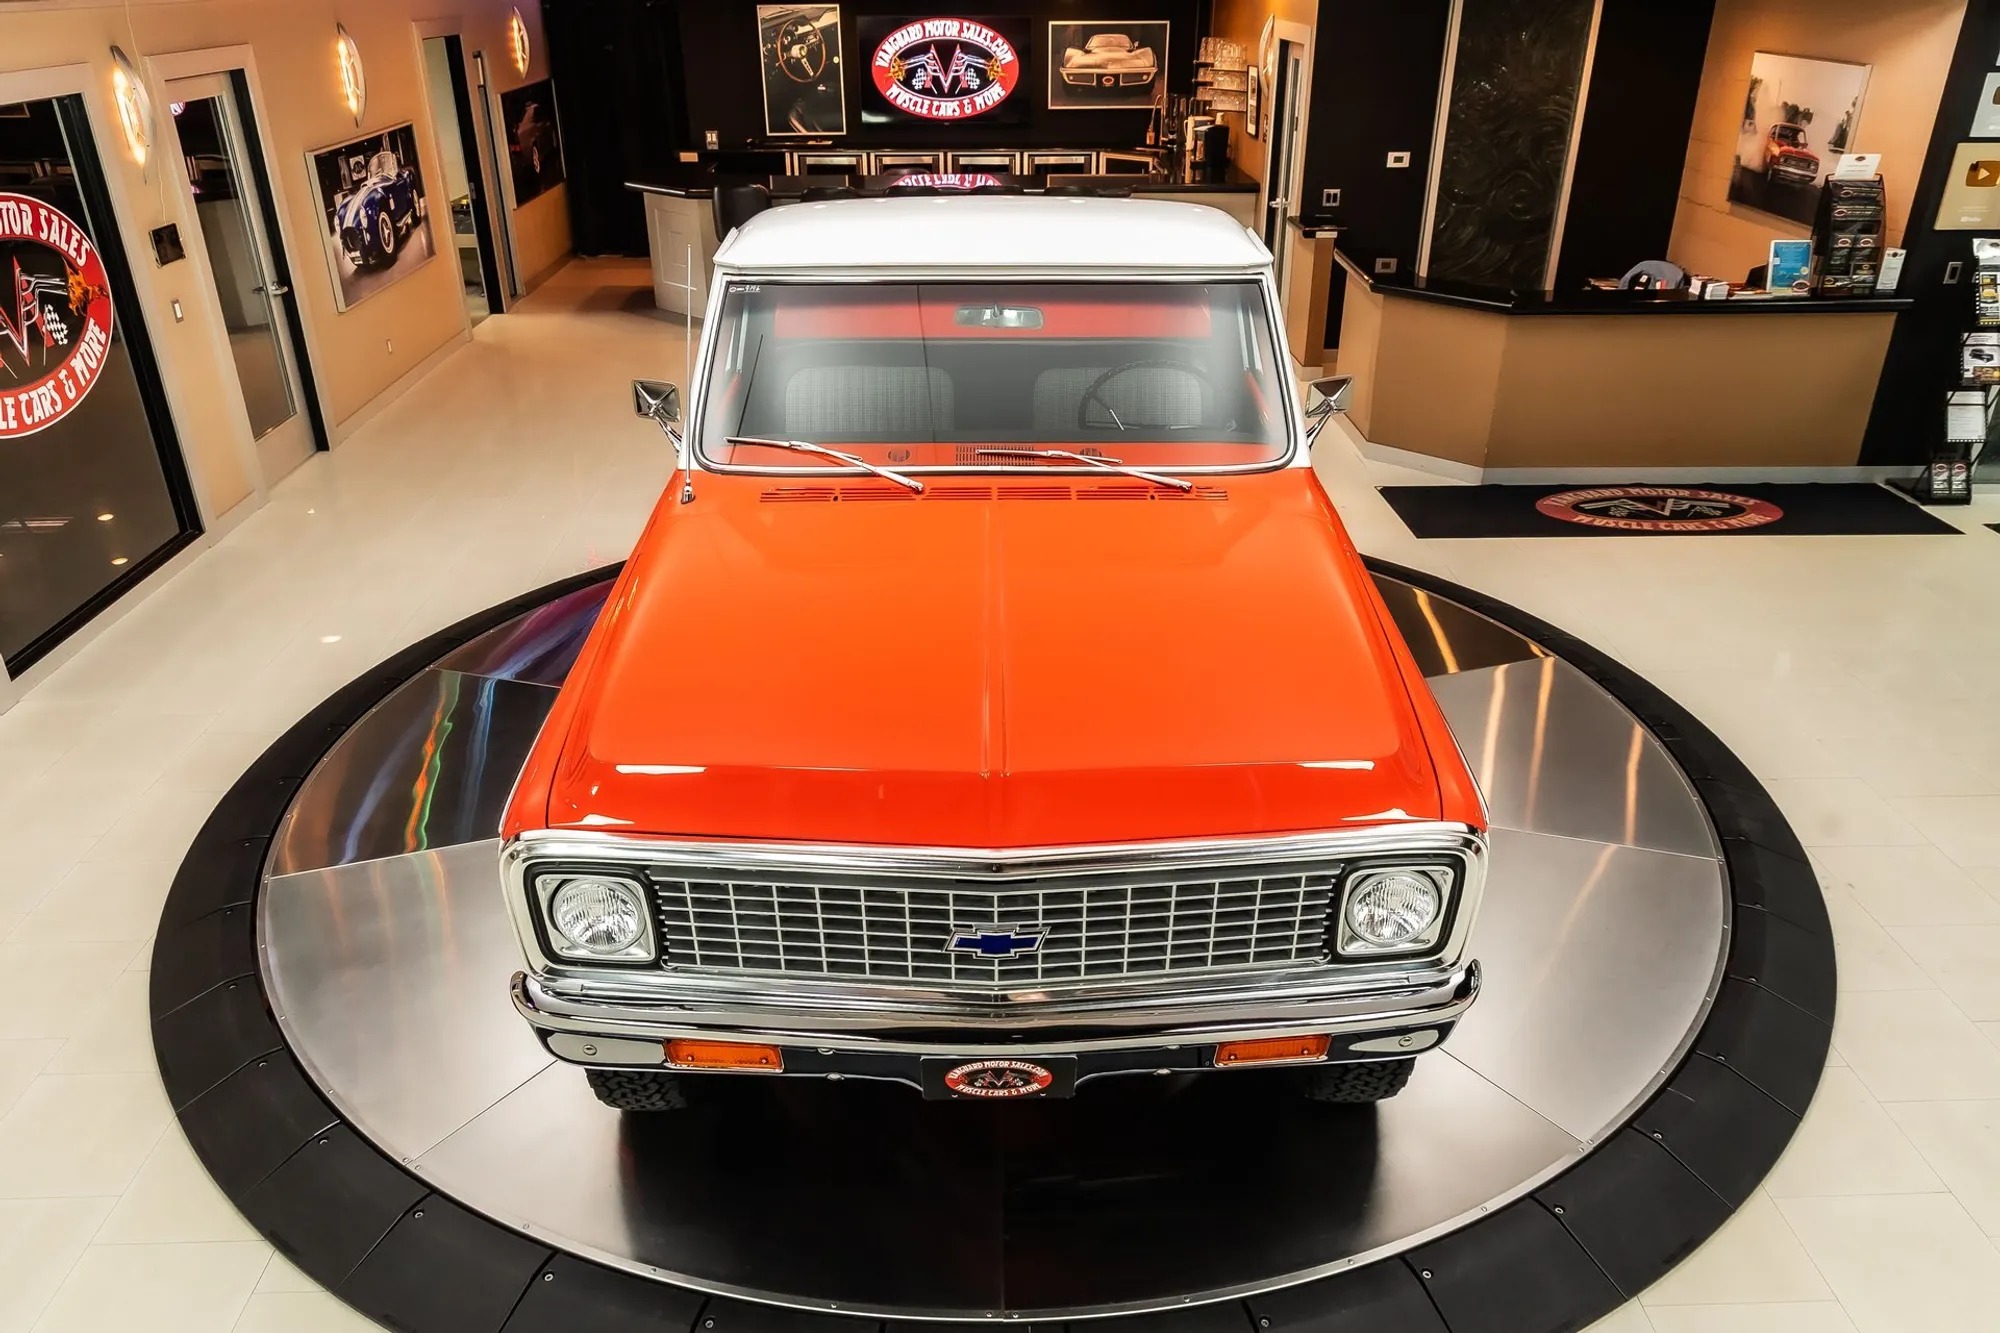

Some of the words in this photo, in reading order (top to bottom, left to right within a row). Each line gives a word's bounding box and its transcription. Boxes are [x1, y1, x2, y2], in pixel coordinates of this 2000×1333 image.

[875, 23, 924, 67] VANGUARD
[925, 20, 960, 38] MOTOR
[961, 22, 1013, 64] SALES.COM
[886, 84, 929, 115] MUSCLE
[932, 101, 960, 117] CARS
[964, 99, 973, 114] &
[973, 83, 1006, 110] MORE
[0, 200, 33, 236] TOR
[39, 207, 90, 267] SALES
[18, 379, 62, 425] CARS
[58, 369, 76, 400] &
[70, 317, 106, 387] MORE
[1625, 488, 1690, 497] MOTOR
[1572, 515, 1654, 530] MUSCLE
[1659, 521, 1709, 531] CARS
[955, 1083, 987, 1095] MUSCLE
[1019, 1083, 1041, 1093] MORE
